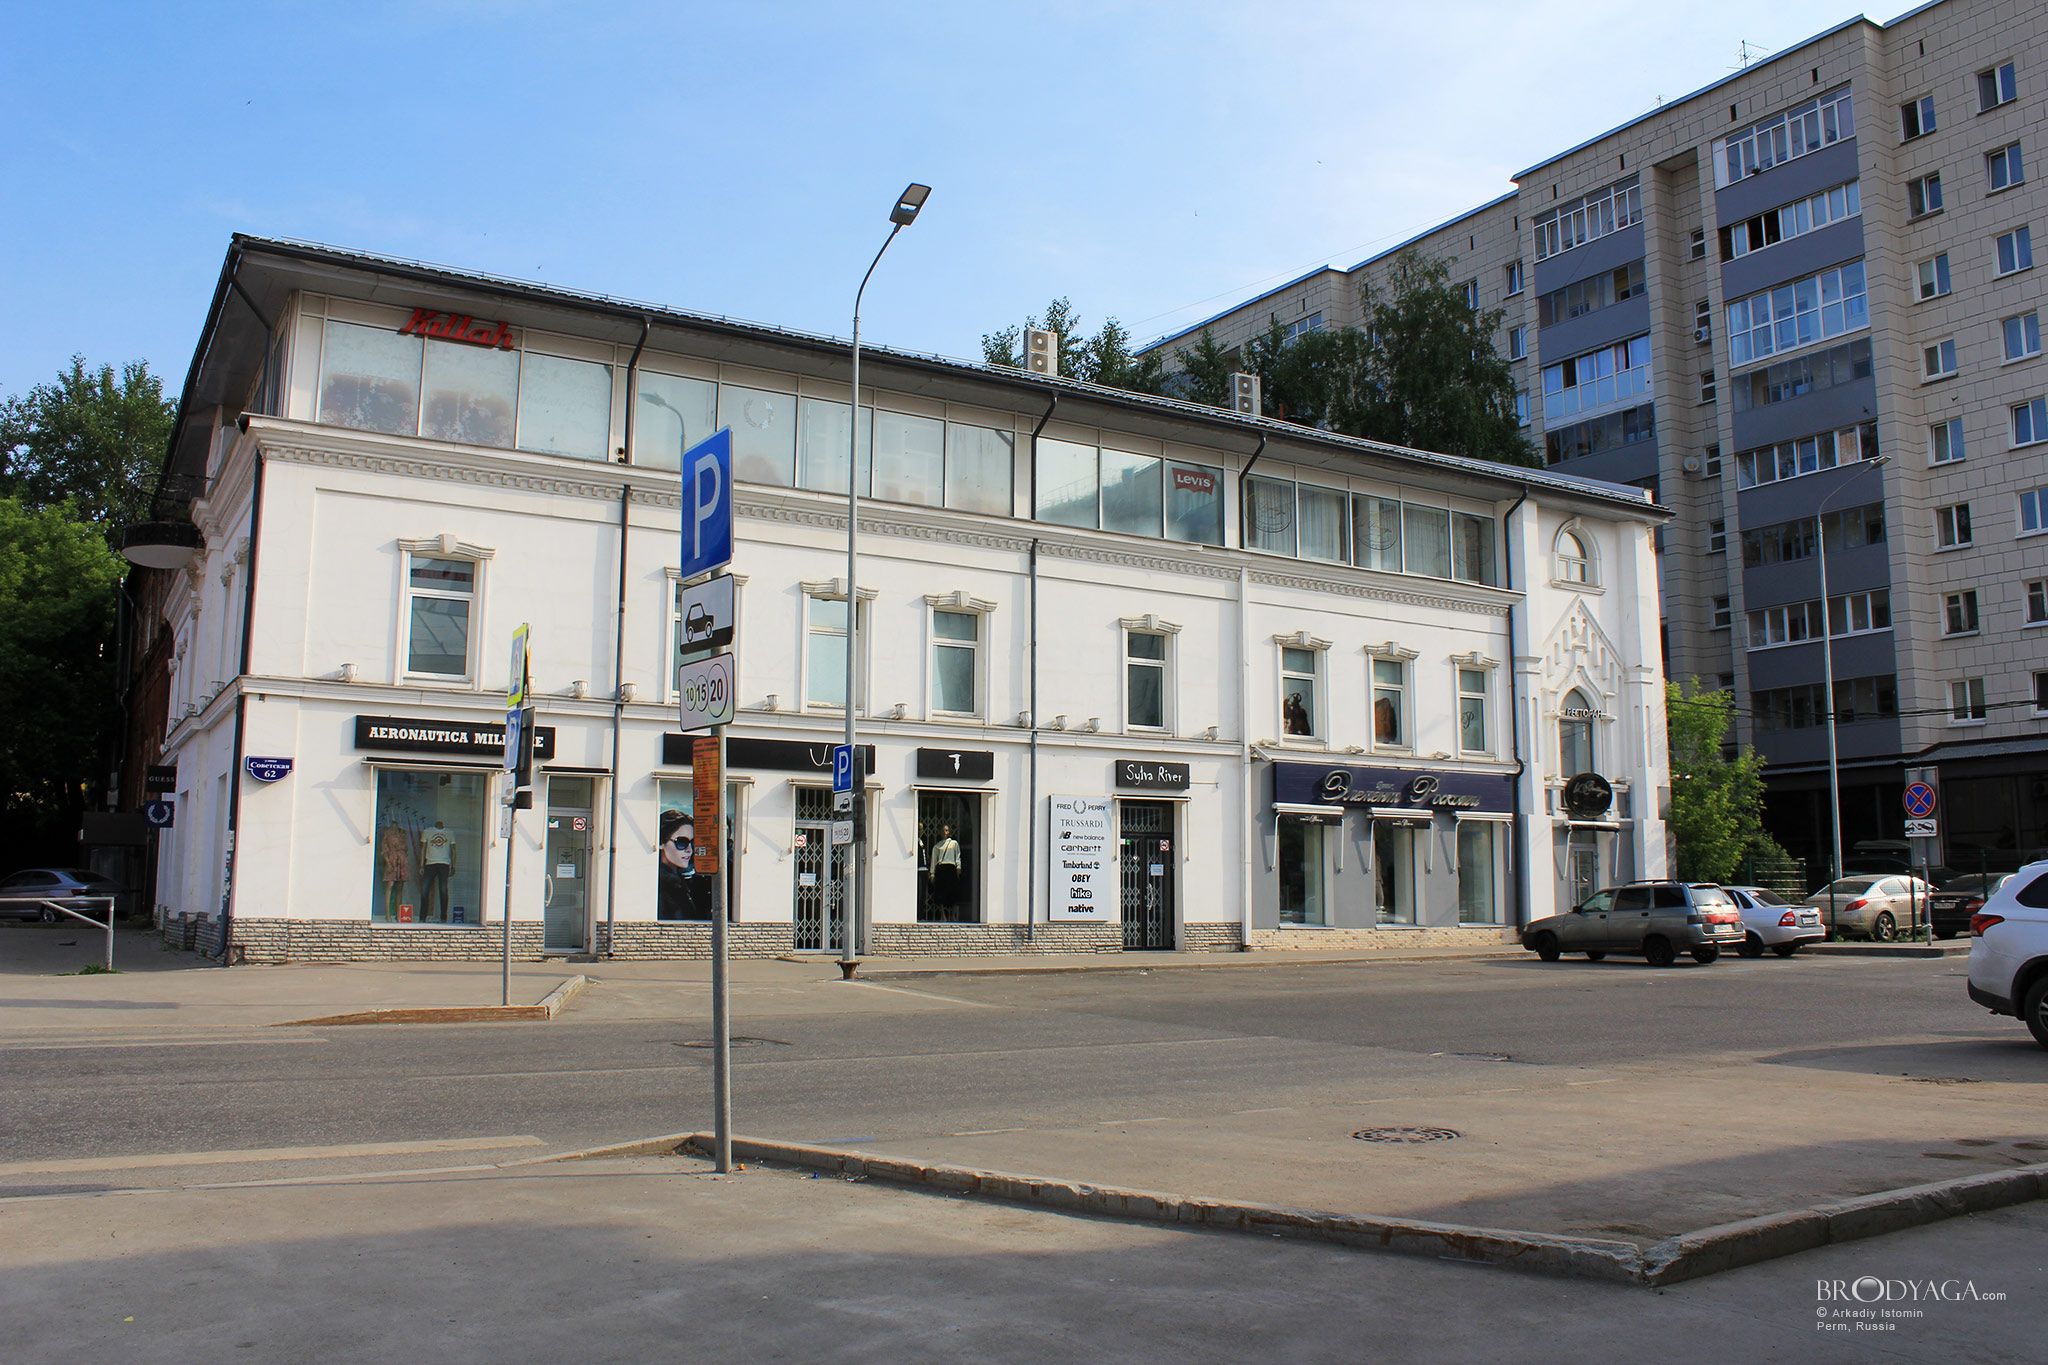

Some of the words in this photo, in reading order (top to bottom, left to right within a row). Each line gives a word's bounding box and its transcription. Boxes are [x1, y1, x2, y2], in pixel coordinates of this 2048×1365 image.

[400, 308, 515, 348] Killah
[694, 453, 721, 559] P
[686, 688, 694, 702] 10
[696, 683, 707, 702] 15
[710, 678, 723, 702] 20
[369, 726, 469, 743] AERONAUTICA
[473, 732, 544, 748] MILIE
[250, 761, 290, 769] Советская
[838, 751, 849, 787] P
[148, 775, 175, 783] GUESS
[264, 770, 277, 778] 62
[1157, 766, 1183, 783] River
[1060, 818, 1103, 828] TRUSSARDI
[1061, 844, 1101, 853] carhartt
[1062, 860, 1093, 869] Timberland
[1071, 874, 1091, 883] OBEY
[1071, 887, 1092, 899] hike
[1068, 904, 1094, 913] native
